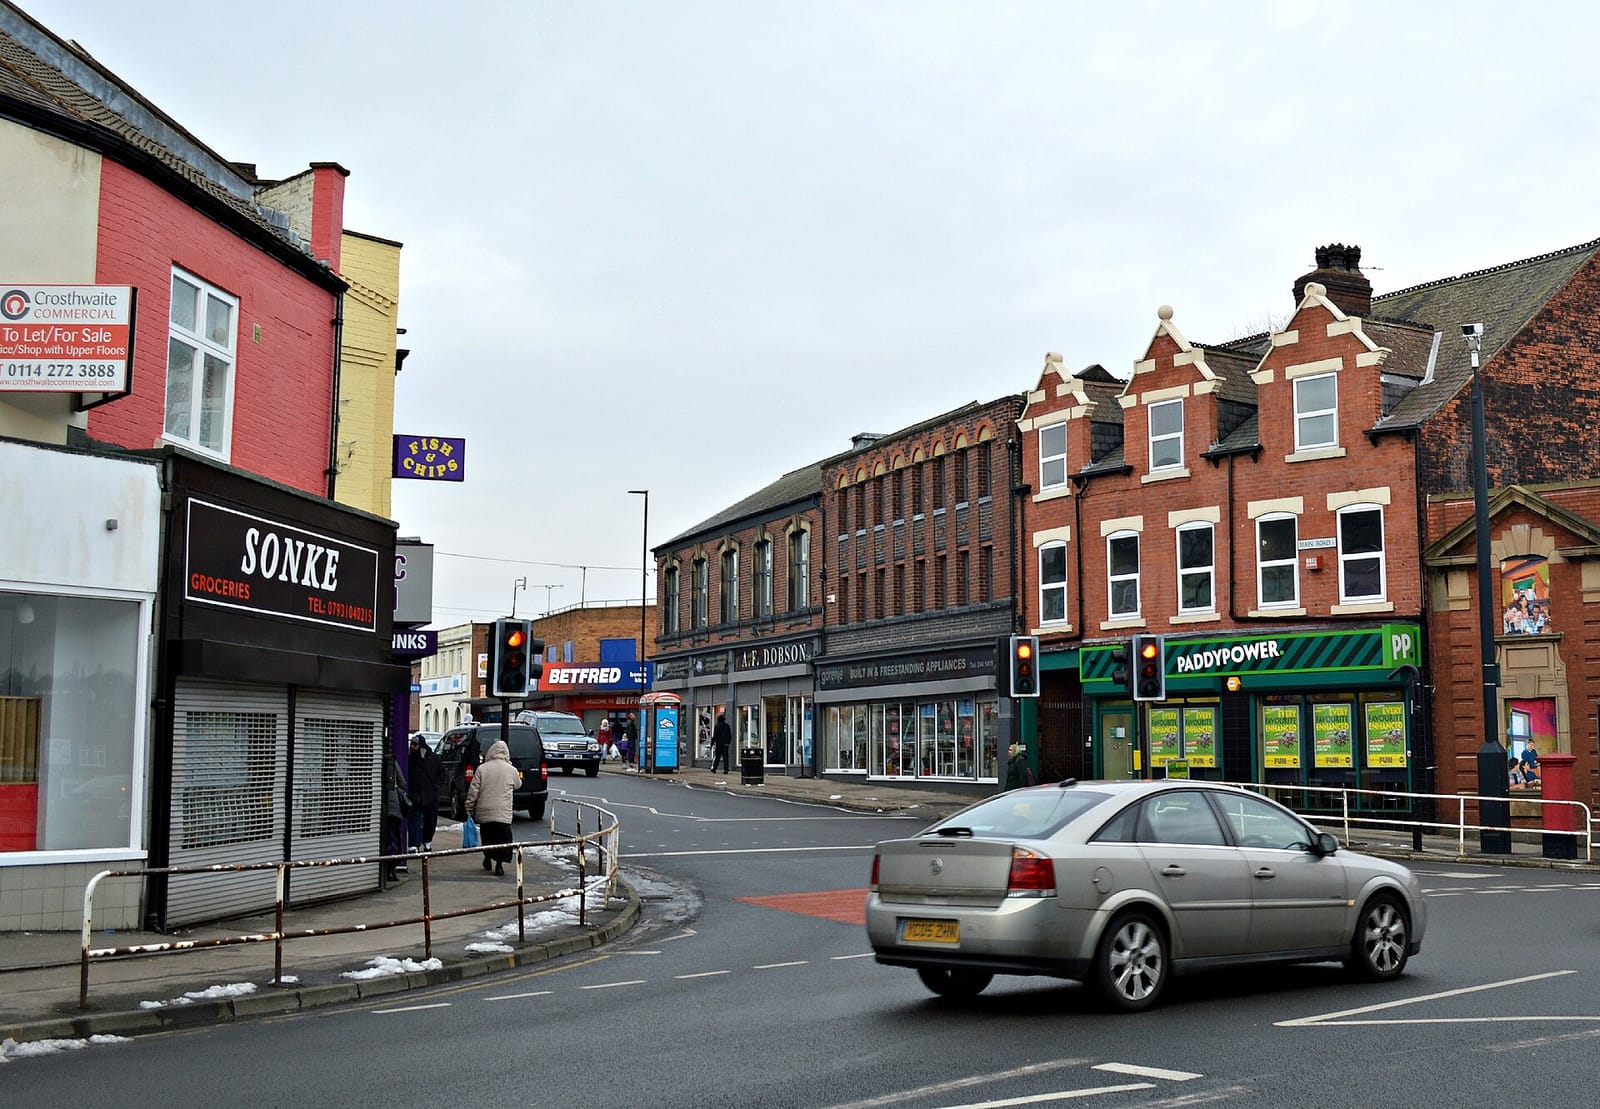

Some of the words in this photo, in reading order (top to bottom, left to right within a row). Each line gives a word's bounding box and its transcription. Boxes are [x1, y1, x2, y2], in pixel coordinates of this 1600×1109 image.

[34, 291, 118, 306] Crosthwaite
[34, 308, 116, 320] COMMERCIAL
[2, 327, 19, 342] To
[23, 326, 79, 344] Let/For
[81, 327, 112, 343] Sale
[44, 345, 64, 355] with
[66, 345, 95, 357] Upper
[96, 345, 126, 356] Floors
[8, 363, 42, 377] 0114
[47, 364, 74, 378] 272
[78, 364, 115, 378] 3888
[408, 438, 454, 457] FISH
[425, 453, 436, 463] &
[403, 457, 458, 478] CHIPS
[240, 527, 340, 592] SONKE
[191, 572, 251, 600] GROCERIES
[308, 596, 326, 615] TEL:
[327, 600, 373, 623] 07931040215
[763, 643, 806, 665] DOBSON
[548, 667, 622, 684] BETFRED
[850, 667, 866, 680] BUILT
[879, 661, 924, 677] FREESTANDING
[925, 658, 967, 672] APPLIANCES
[1382, 706, 1402, 715] EVERY
